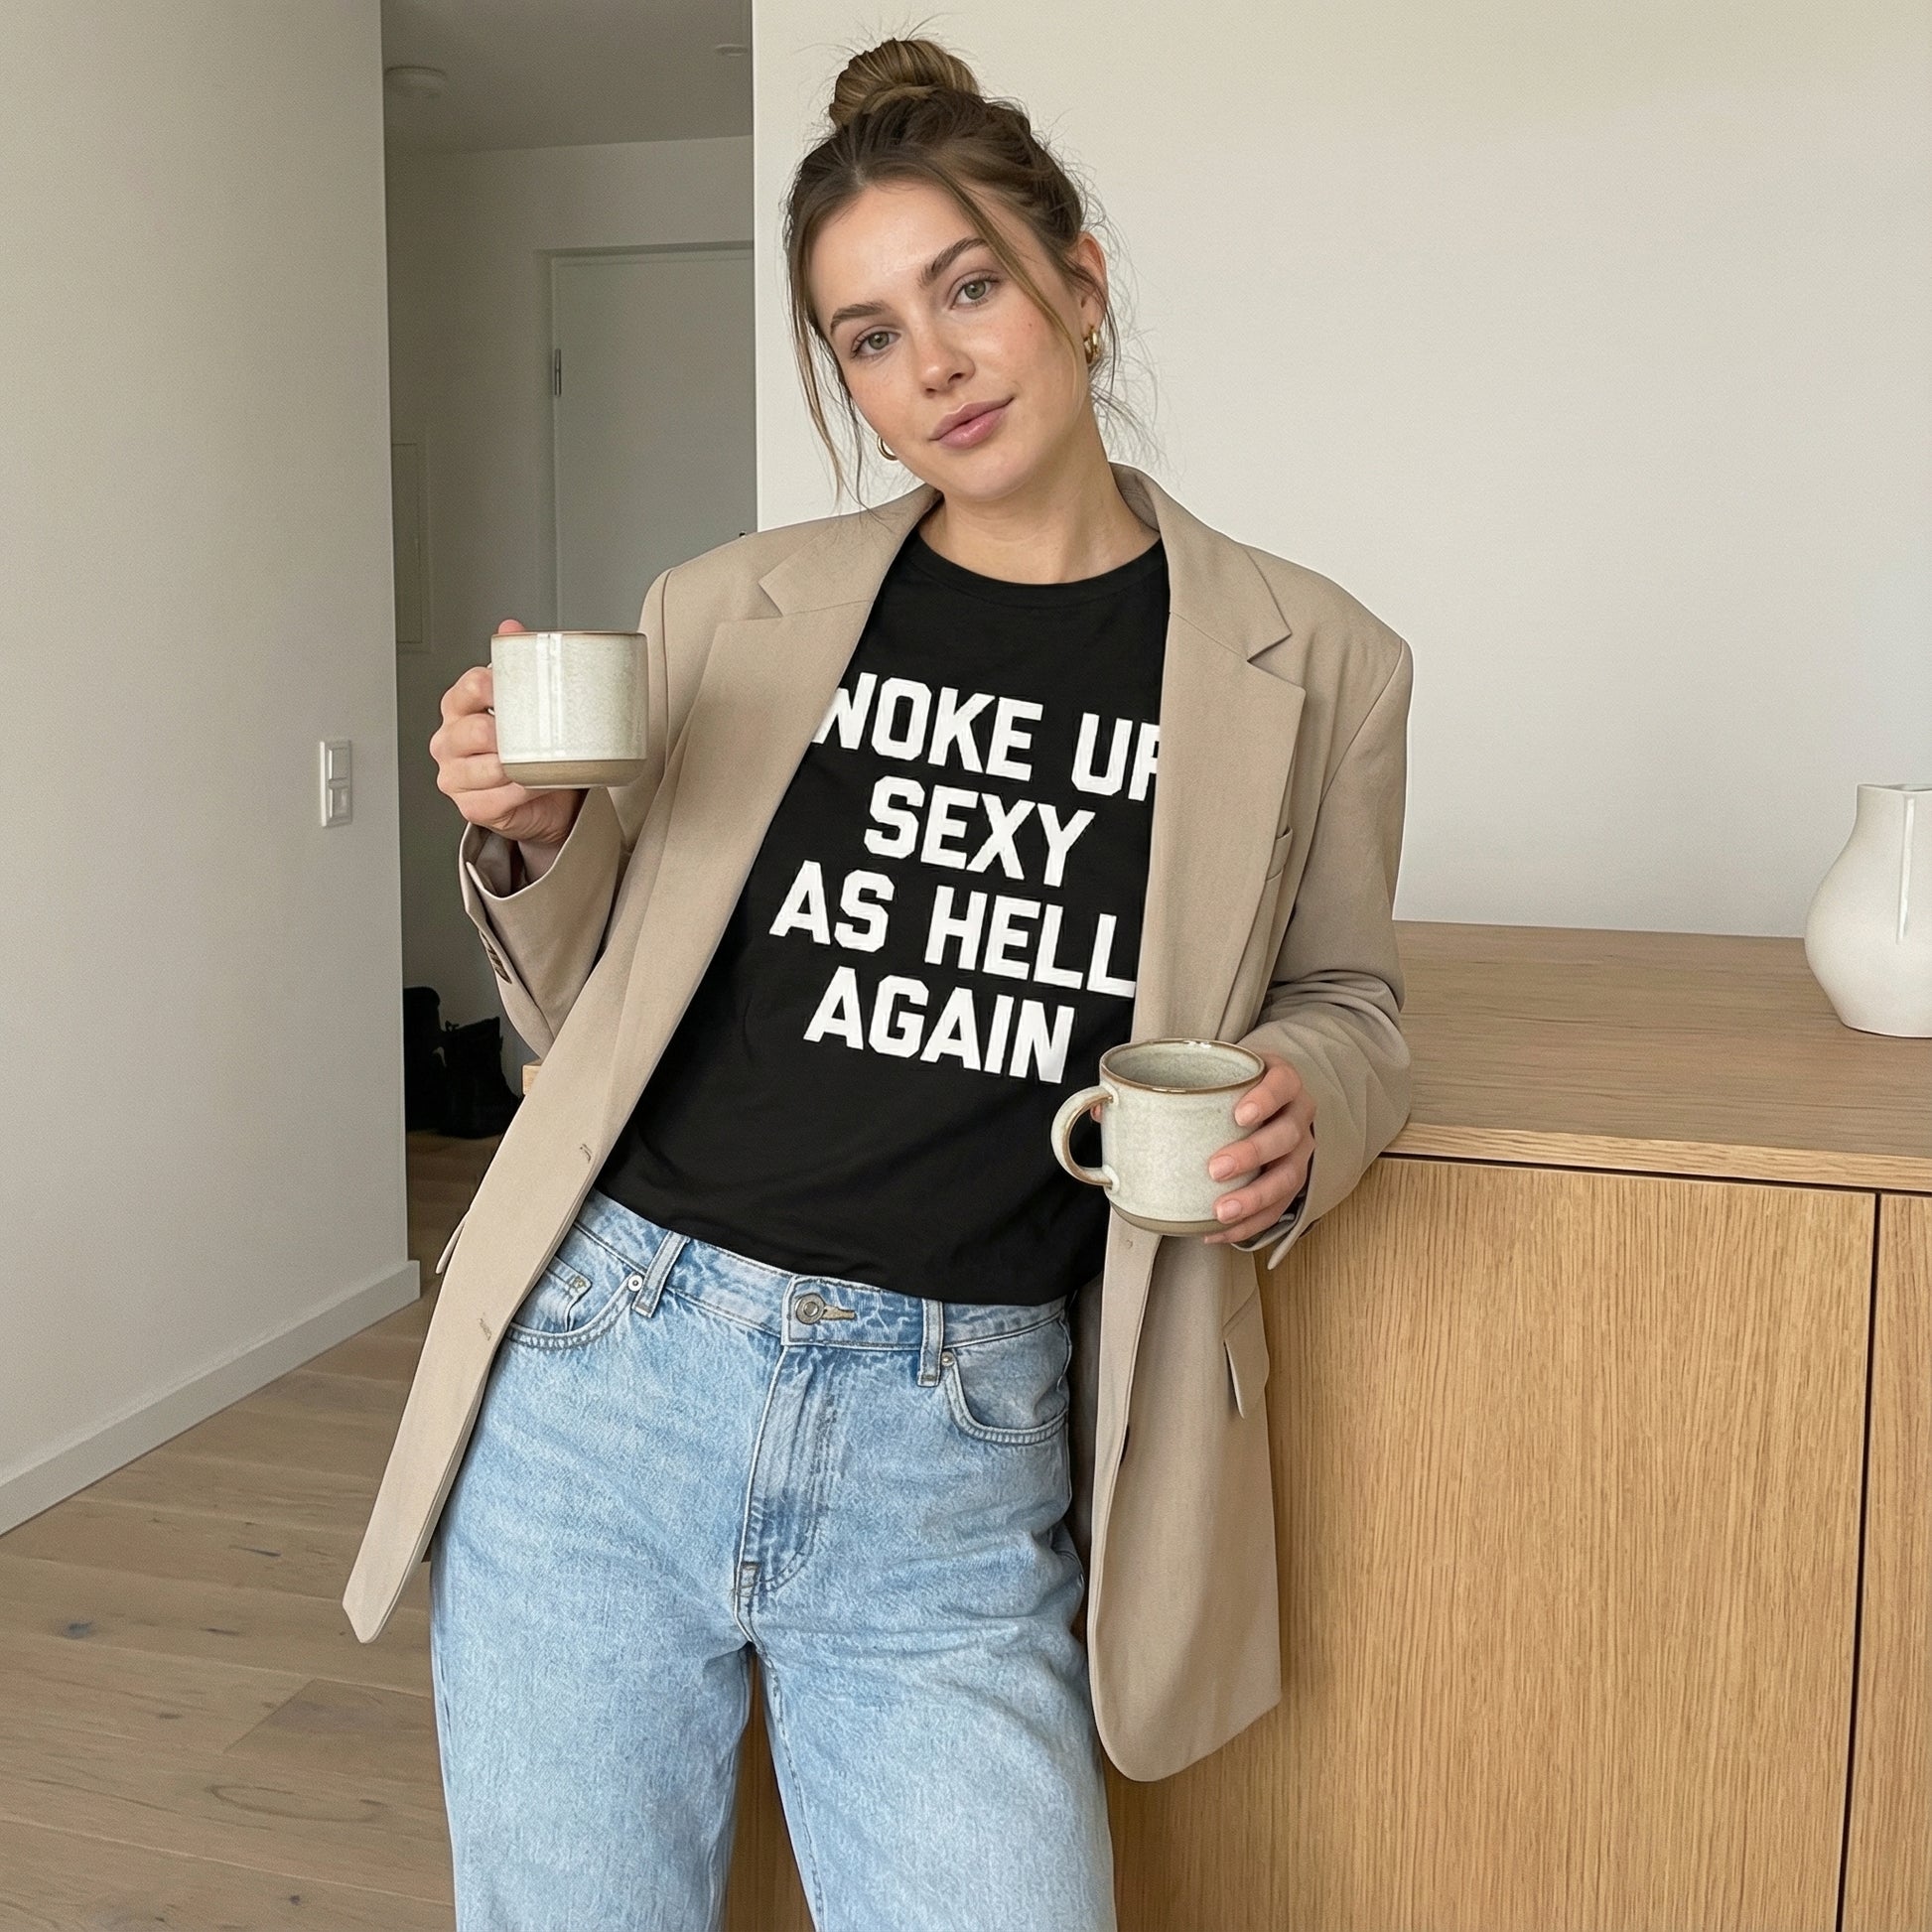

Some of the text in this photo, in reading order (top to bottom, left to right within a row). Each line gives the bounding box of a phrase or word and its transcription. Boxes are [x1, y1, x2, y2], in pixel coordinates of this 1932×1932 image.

[864, 775, 1095, 887] SEXY
[769, 860, 1137, 999] AS HELL
[803, 966, 1075, 1084] AGAIN
